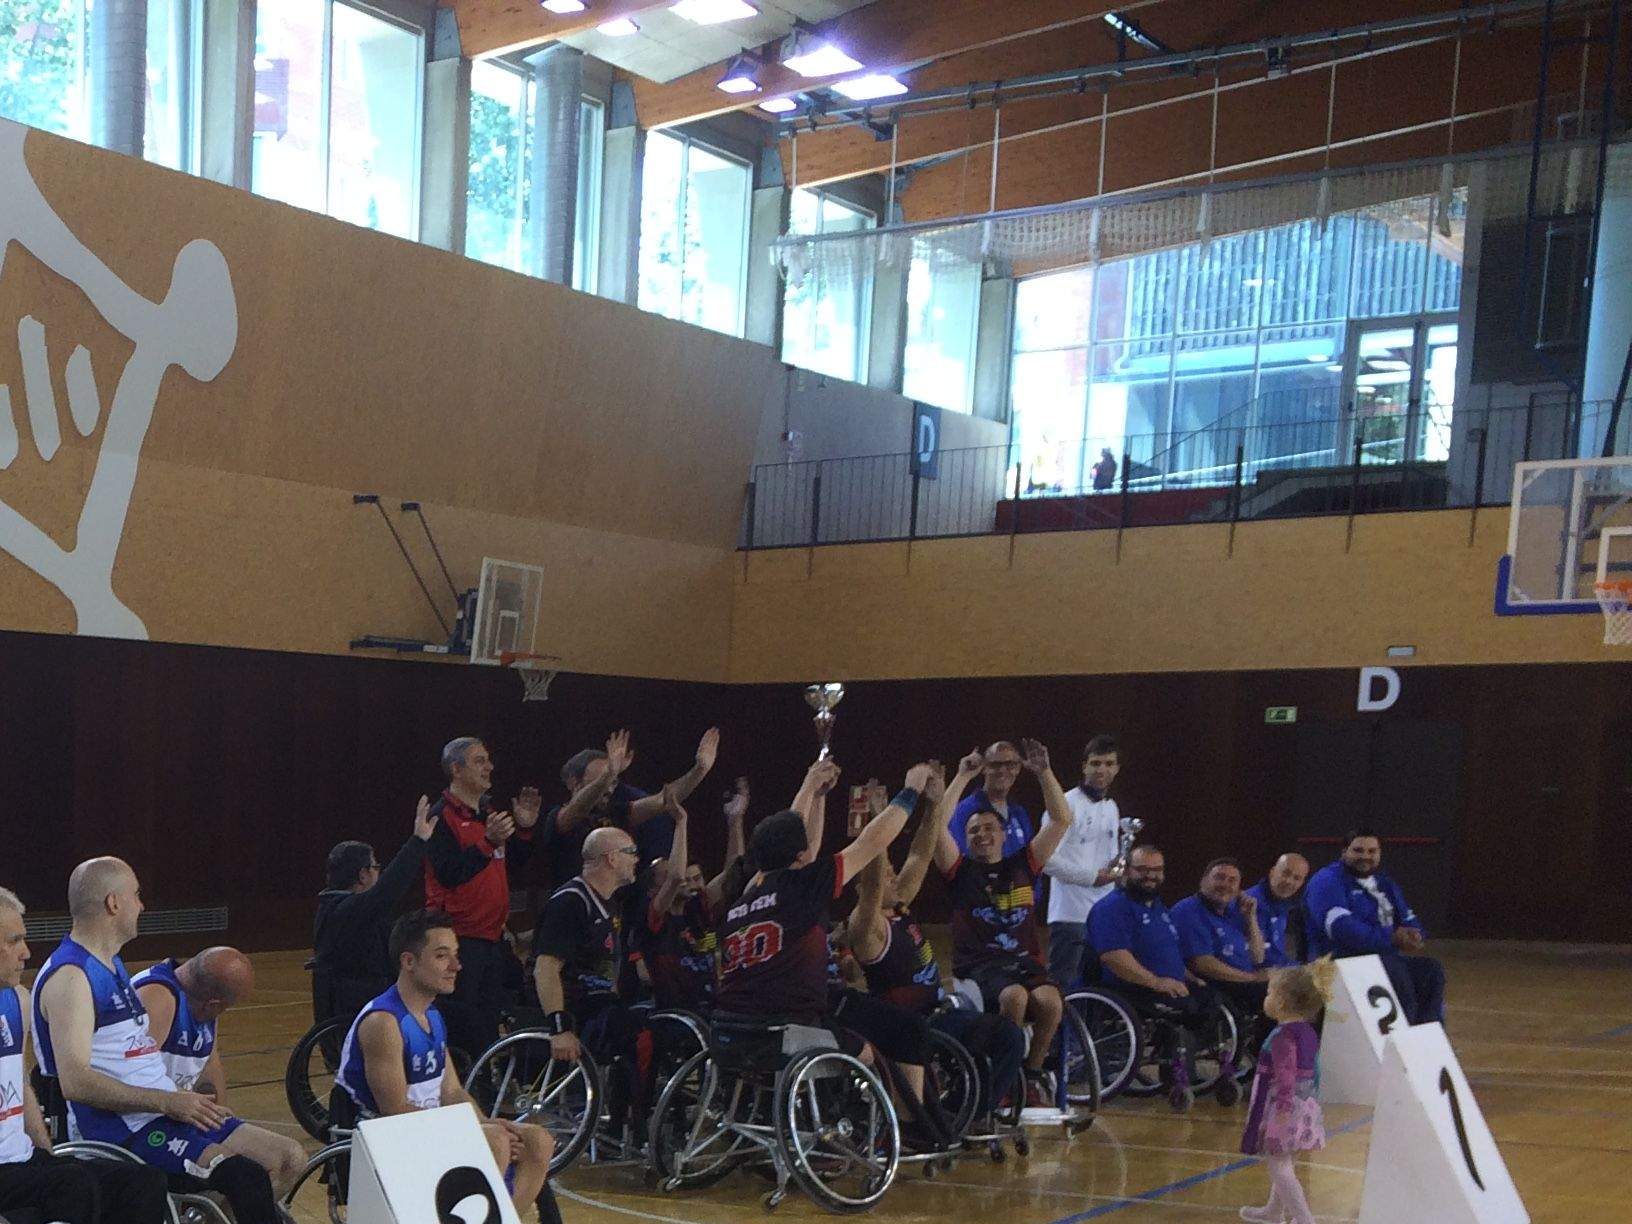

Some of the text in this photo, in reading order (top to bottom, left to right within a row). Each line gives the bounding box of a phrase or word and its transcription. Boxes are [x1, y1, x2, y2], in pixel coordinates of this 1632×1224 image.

[918, 413, 936, 463] D
[1357, 665, 1402, 713] D
[1439, 1065, 1486, 1192] 1
